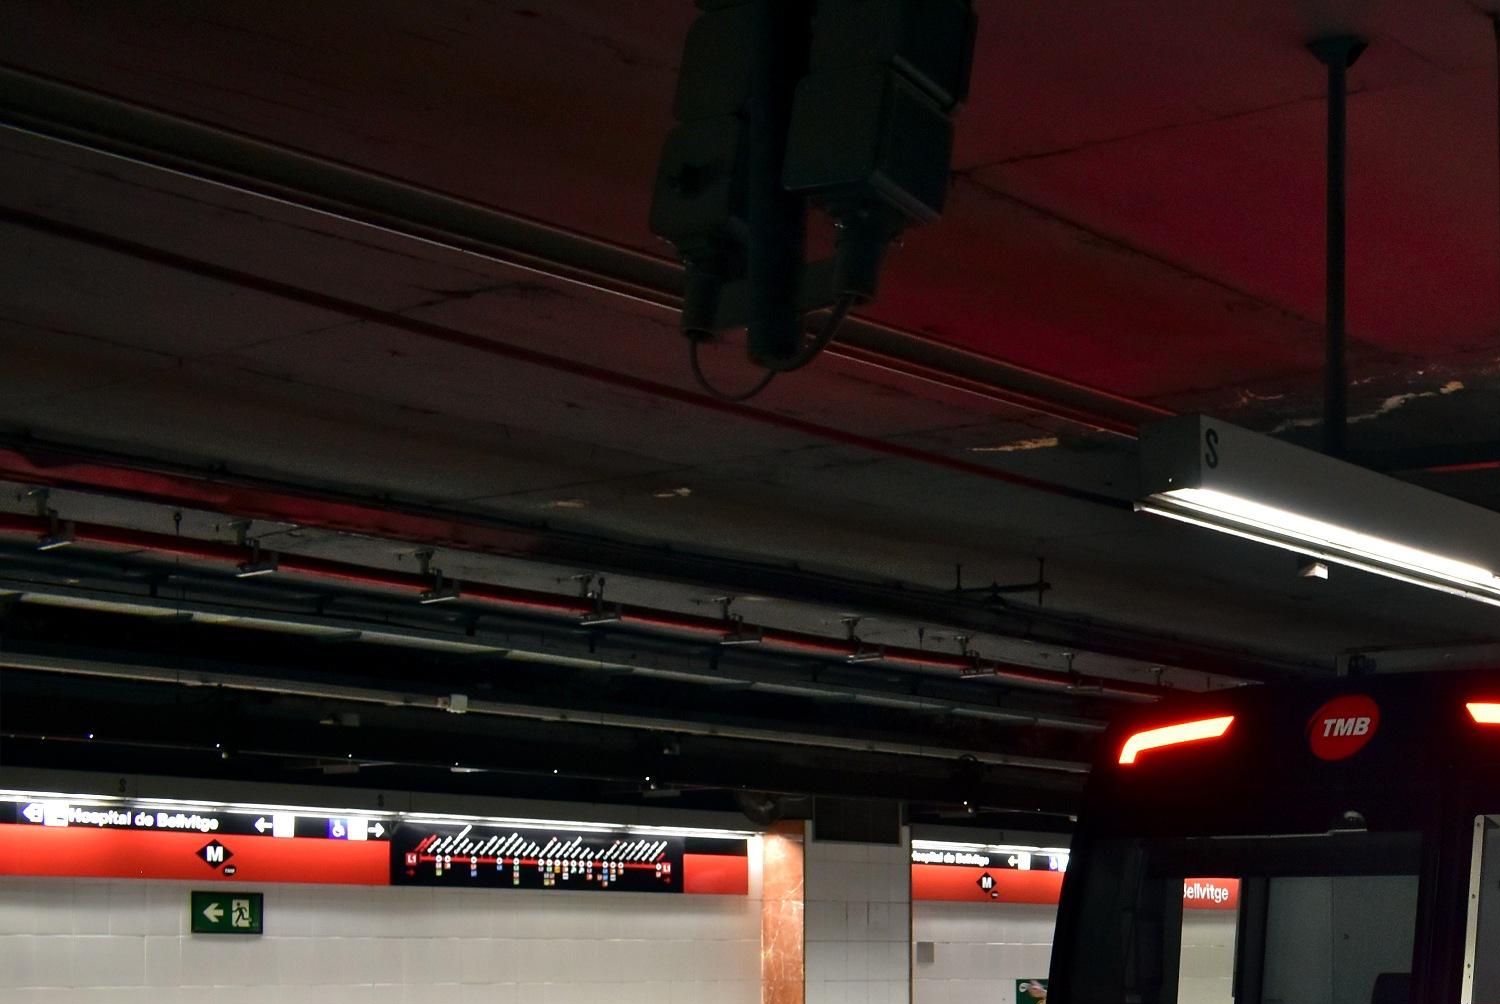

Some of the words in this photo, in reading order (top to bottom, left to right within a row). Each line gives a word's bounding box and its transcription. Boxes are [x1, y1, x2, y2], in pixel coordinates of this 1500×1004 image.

[1322, 716, 1371, 737] TMB
[68, 808, 131, 829] Hospital
[135, 812, 154, 828] de
[157, 813, 219, 833] Bellvitge
[206, 845, 224, 862] M
[982, 877, 992, 888] M
